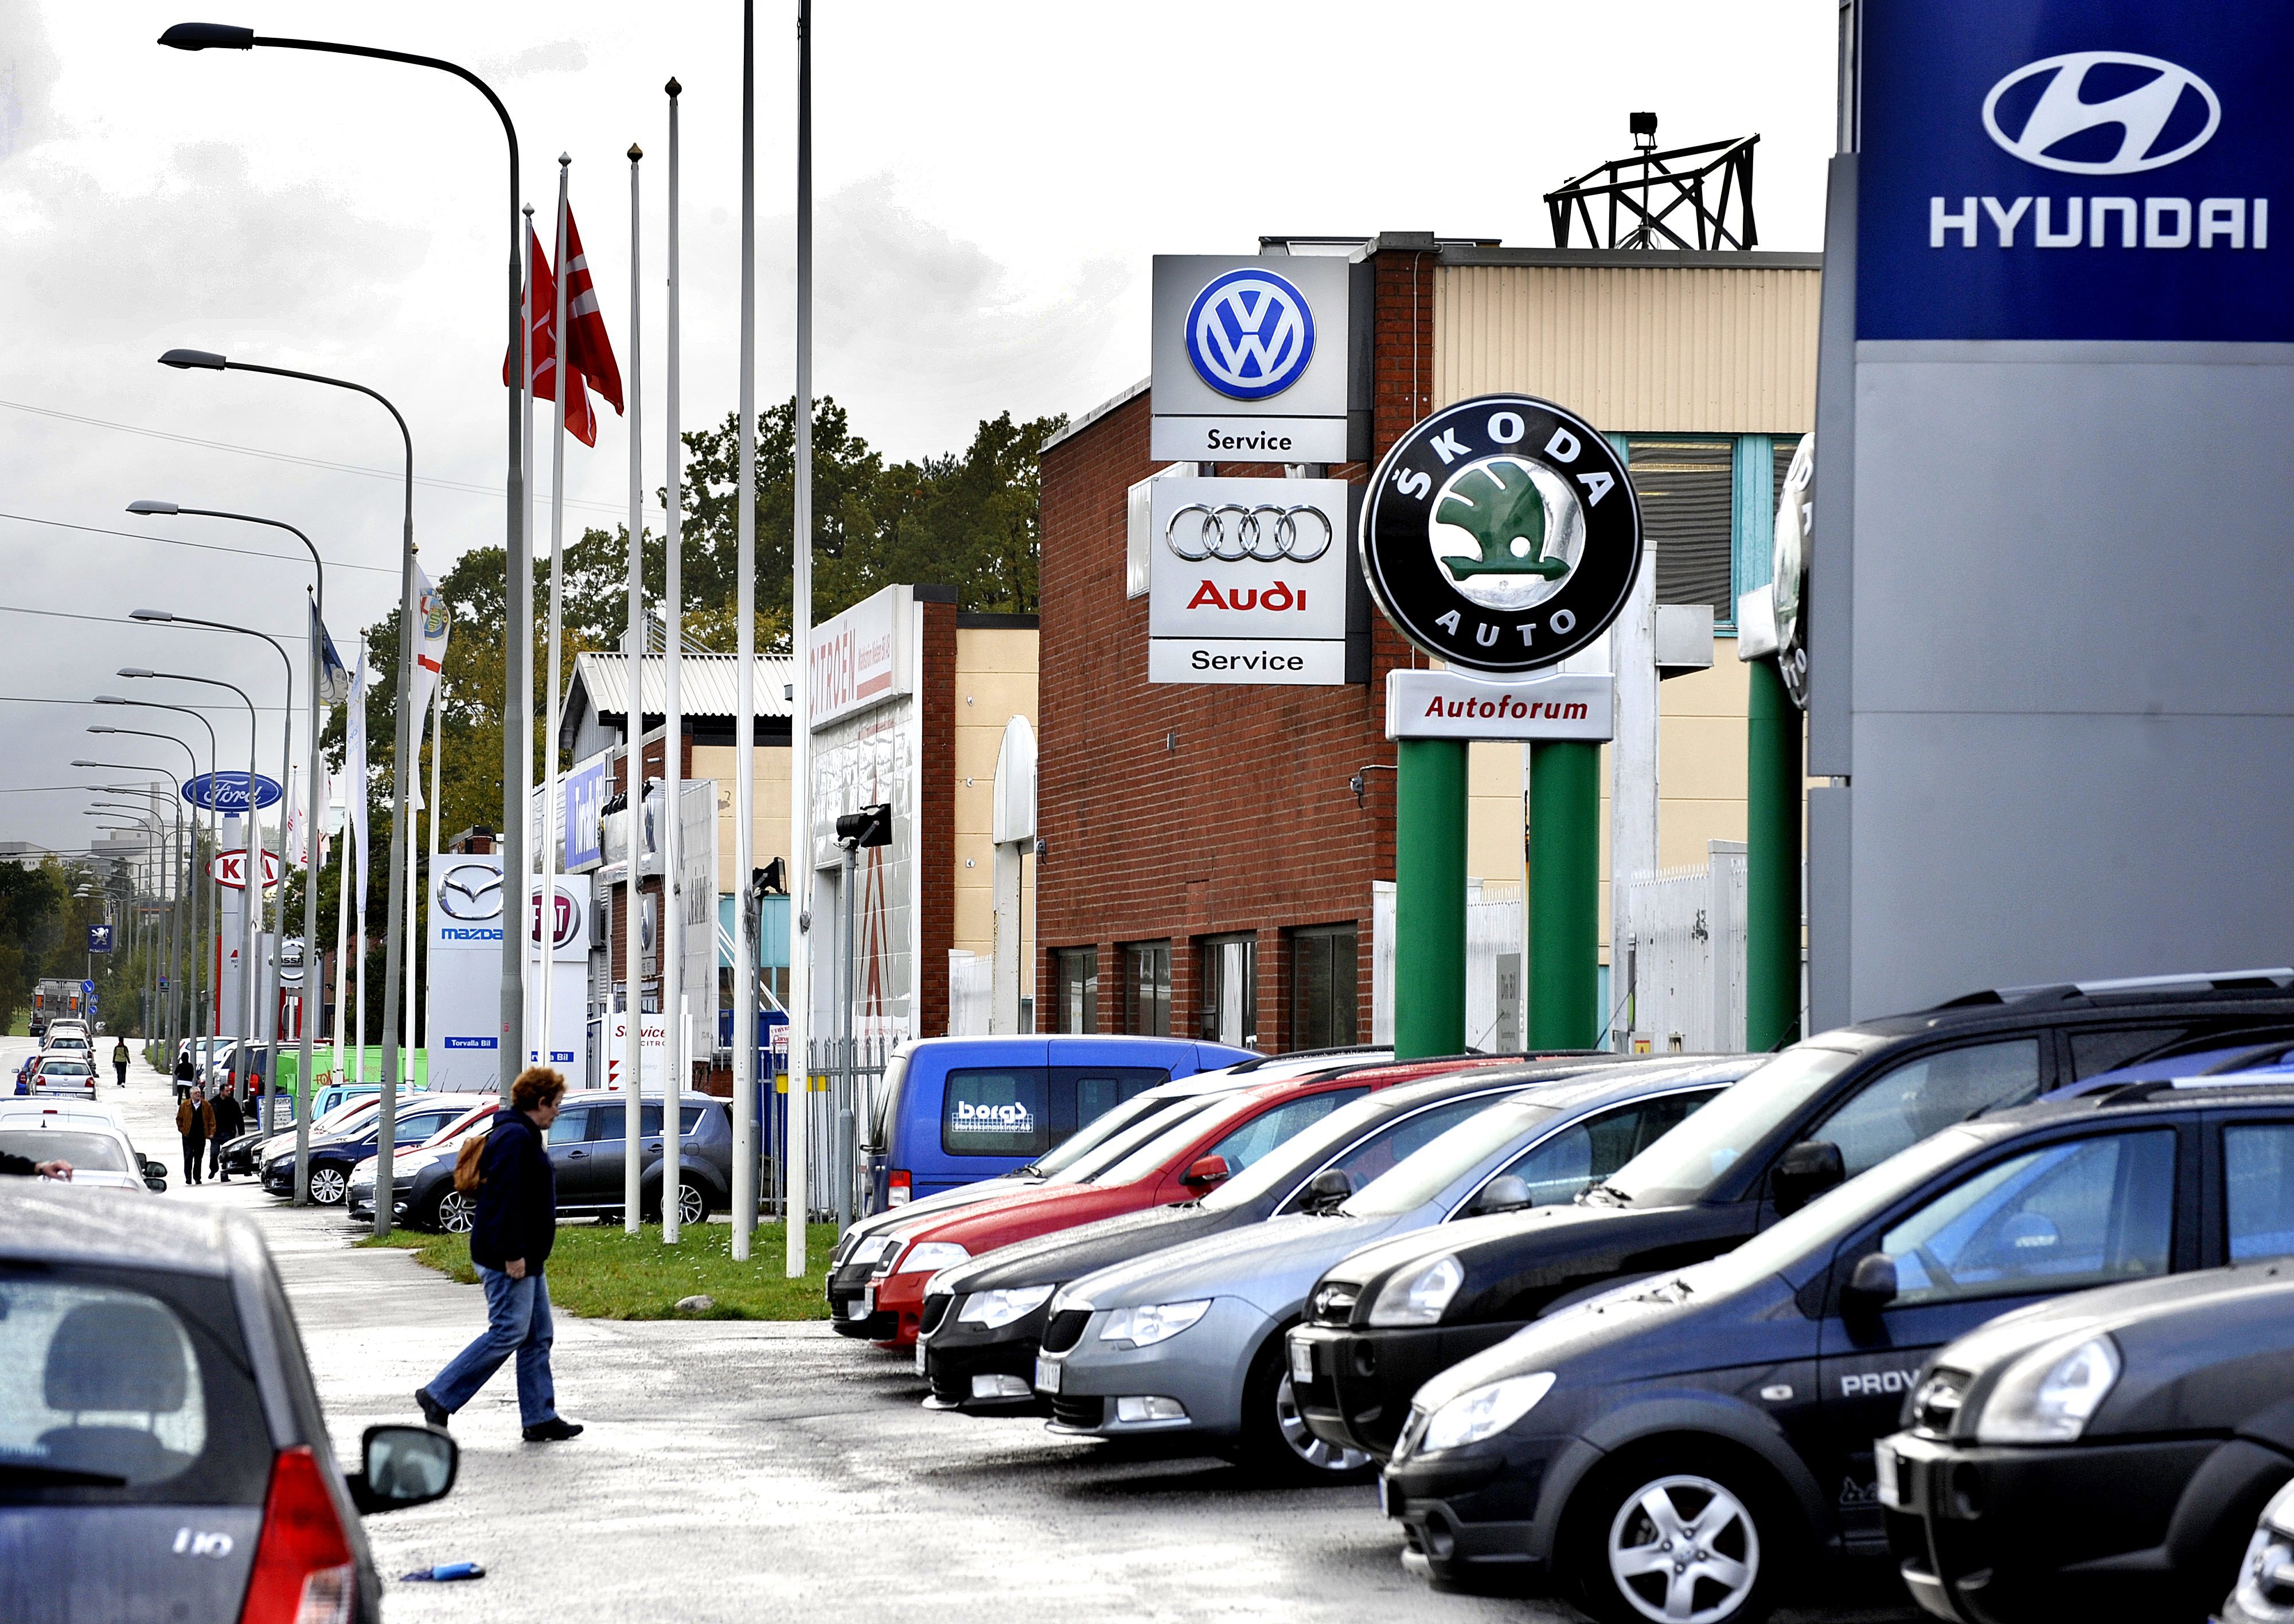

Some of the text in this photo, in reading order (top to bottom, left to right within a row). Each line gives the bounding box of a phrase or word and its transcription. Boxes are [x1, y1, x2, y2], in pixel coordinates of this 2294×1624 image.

[1929, 196, 2268, 249] HYUNDAI
[1207, 429, 1293, 451] Service
[1390, 410, 1616, 508] ŠKODA
[1186, 580, 1307, 612] Audi
[1434, 608, 1577, 647] AUTO
[811, 618, 856, 720] CITROËN
[1191, 650, 1304, 672] Service
[1424, 694, 1588, 720] Autoforum
[204, 779, 263, 803] Ford
[222, 858, 274, 879] KA
[532, 904, 567, 932] FT
[615, 1025, 665, 1037] Svice
[958, 1100, 1027, 1124] borgs
[1841, 1369, 1921, 1397] PROV
